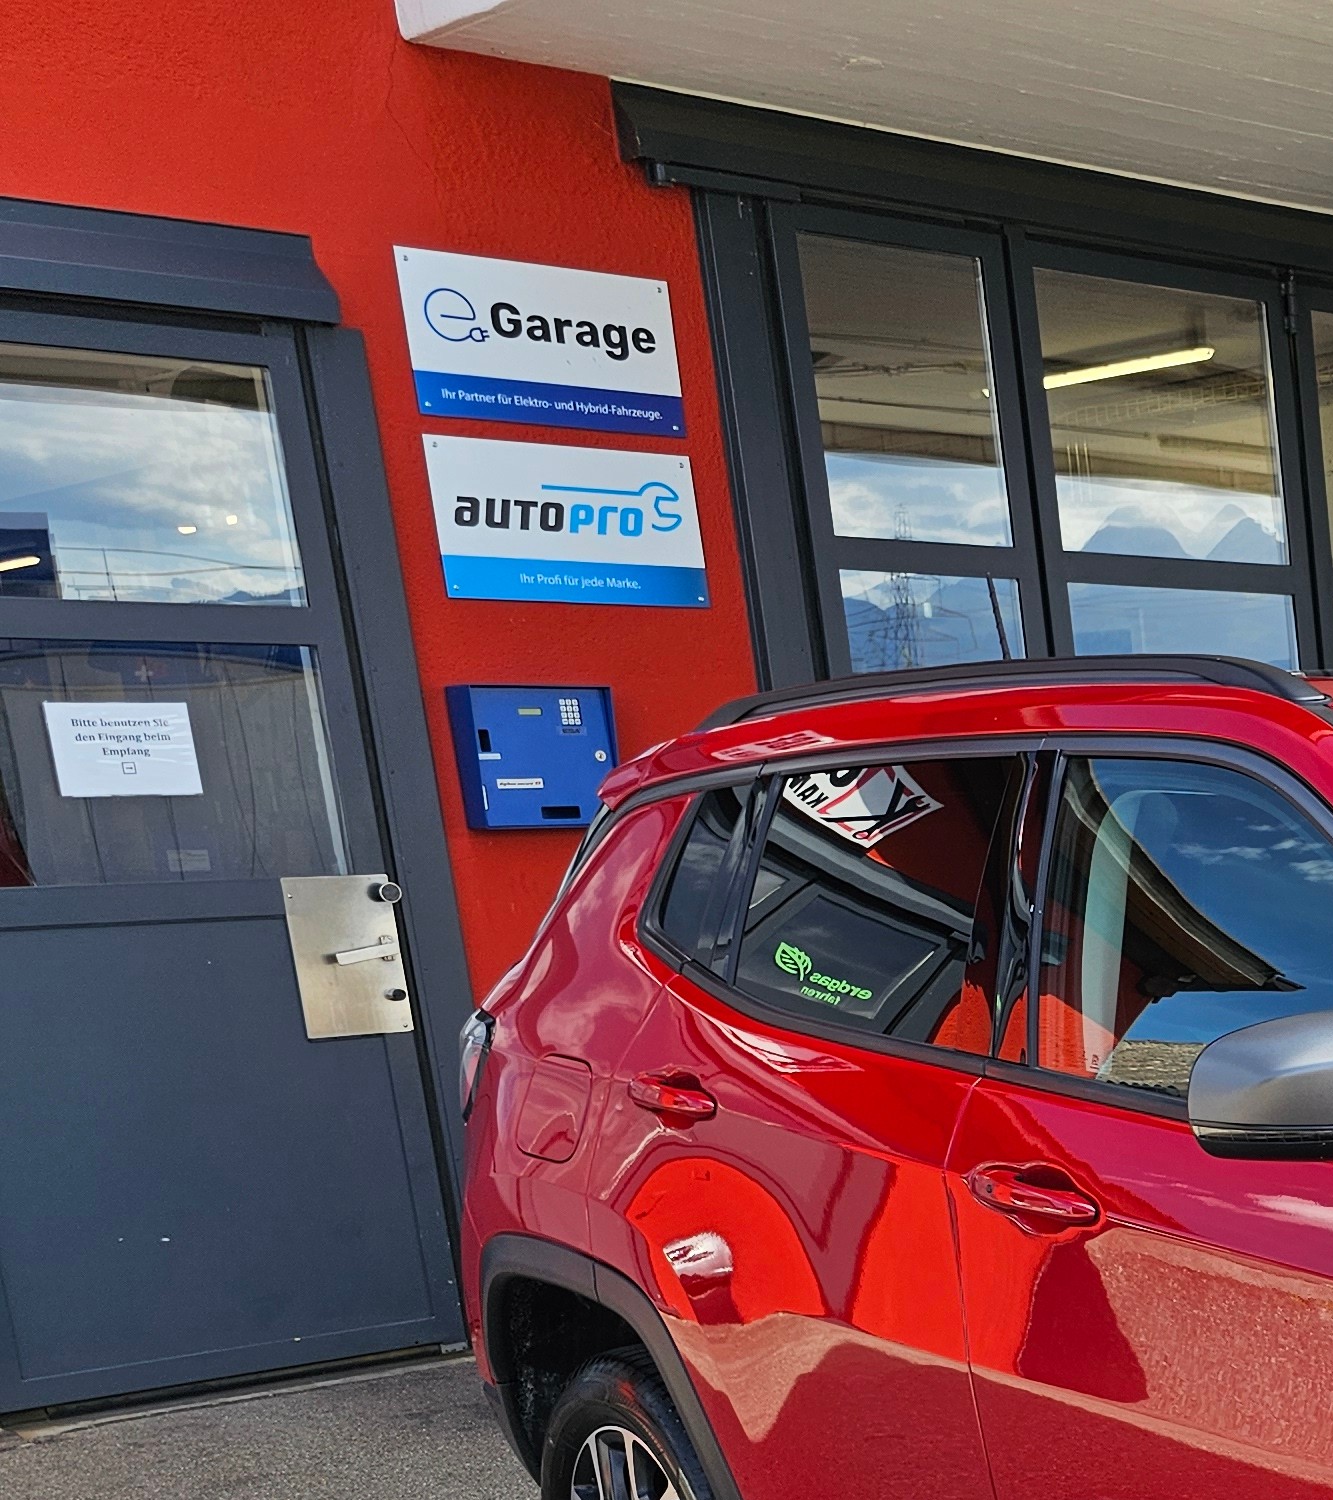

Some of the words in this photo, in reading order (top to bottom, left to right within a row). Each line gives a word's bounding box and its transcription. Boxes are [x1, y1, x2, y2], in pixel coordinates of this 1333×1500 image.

[490, 302, 656, 361] Garage
[441, 388, 456, 400] Ihr
[458, 390, 496, 404] Partner
[498, 393, 513, 406] für
[514, 395, 553, 410] Elektro-
[554, 400, 575, 412] und
[576, 403, 663, 421] Hybrid-Fahrzeuge.
[520, 573, 535, 585] Ihr
[537, 574, 562, 587] Profi
[563, 575, 579, 587] für
[581, 576, 605, 589] jede
[606, 578, 642, 591] Marke.
[70, 718, 98, 727] Bitte
[100, 718, 151, 728] benutzen
[153, 718, 169, 728] Sie
[75, 733, 96, 742] den
[98, 733, 143, 743] Eingang
[144, 733, 171, 742] beim
[102, 747, 151, 757] Empfang
